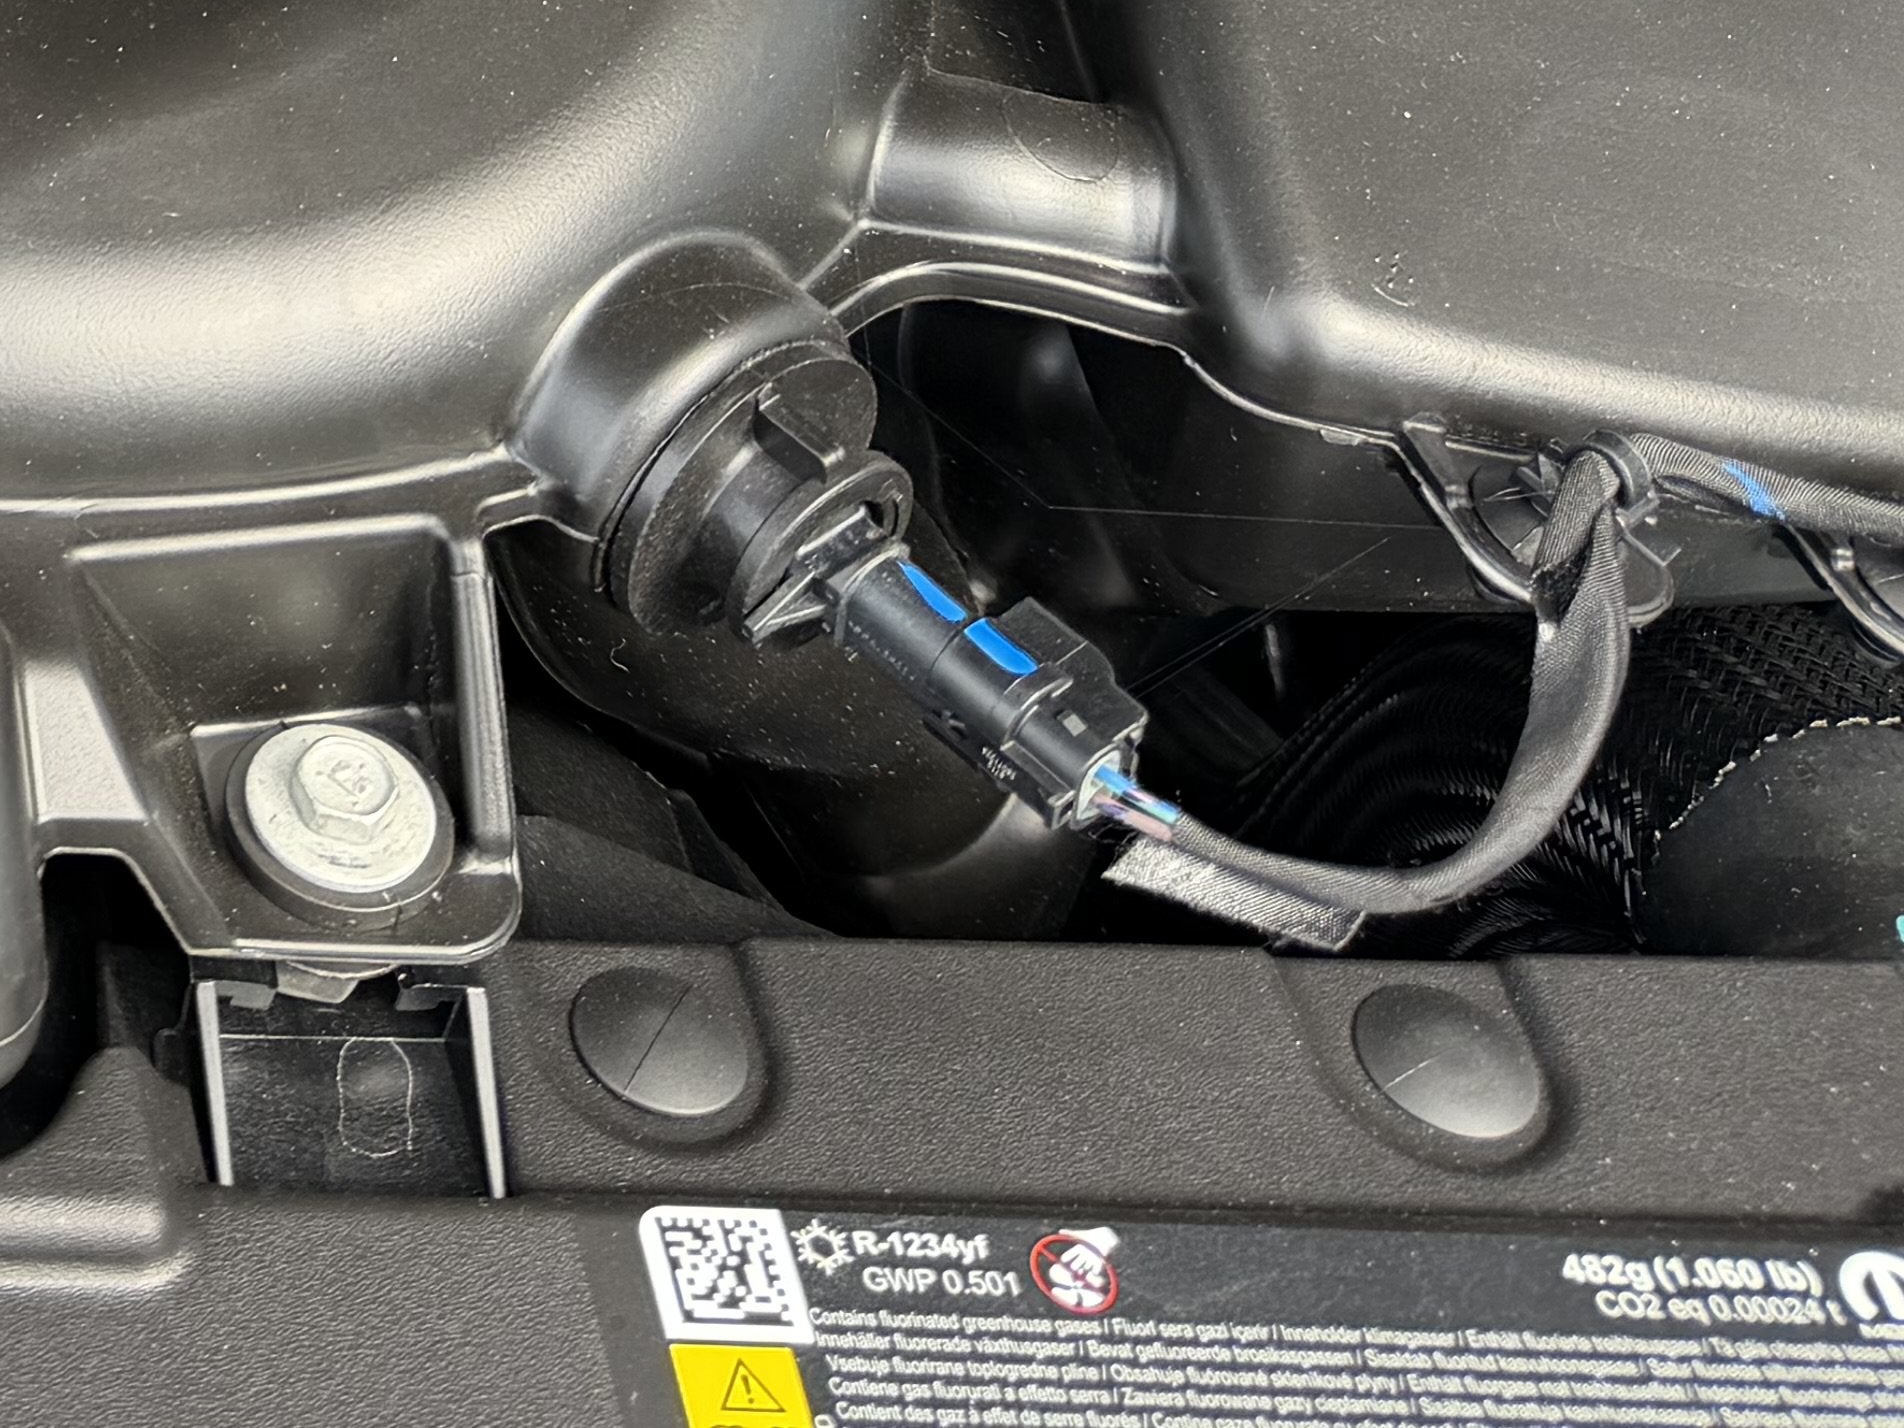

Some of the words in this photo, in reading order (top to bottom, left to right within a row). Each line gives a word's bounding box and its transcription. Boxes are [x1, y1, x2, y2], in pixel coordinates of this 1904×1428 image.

[852, 1230, 990, 1265] R-1234yf
[862, 1266, 937, 1293] GWP
[942, 1269, 1022, 1297] 0.501
[809, 1307, 877, 1328] Contains
[879, 1311, 960, 1330] fluorinated
[962, 1314, 1051, 1335] greenhouse
[1055, 1318, 1103, 1337] gases
[1595, 1290, 1666, 1319] CO2
[1668, 1298, 1711, 1326] eq
[893, 1334, 971, 1354] fluorerade
[825, 1354, 891, 1377] Vsebuje
[829, 1376, 898, 1396] Contiene
[901, 1382, 930, 1400] gas
[1003, 1386, 1016, 1401] a
[835, 1401, 902, 1422] Contient
[904, 1404, 932, 1424] des
[936, 1408, 965, 1428] gaz
[1019, 1408, 1040, 1426] de
